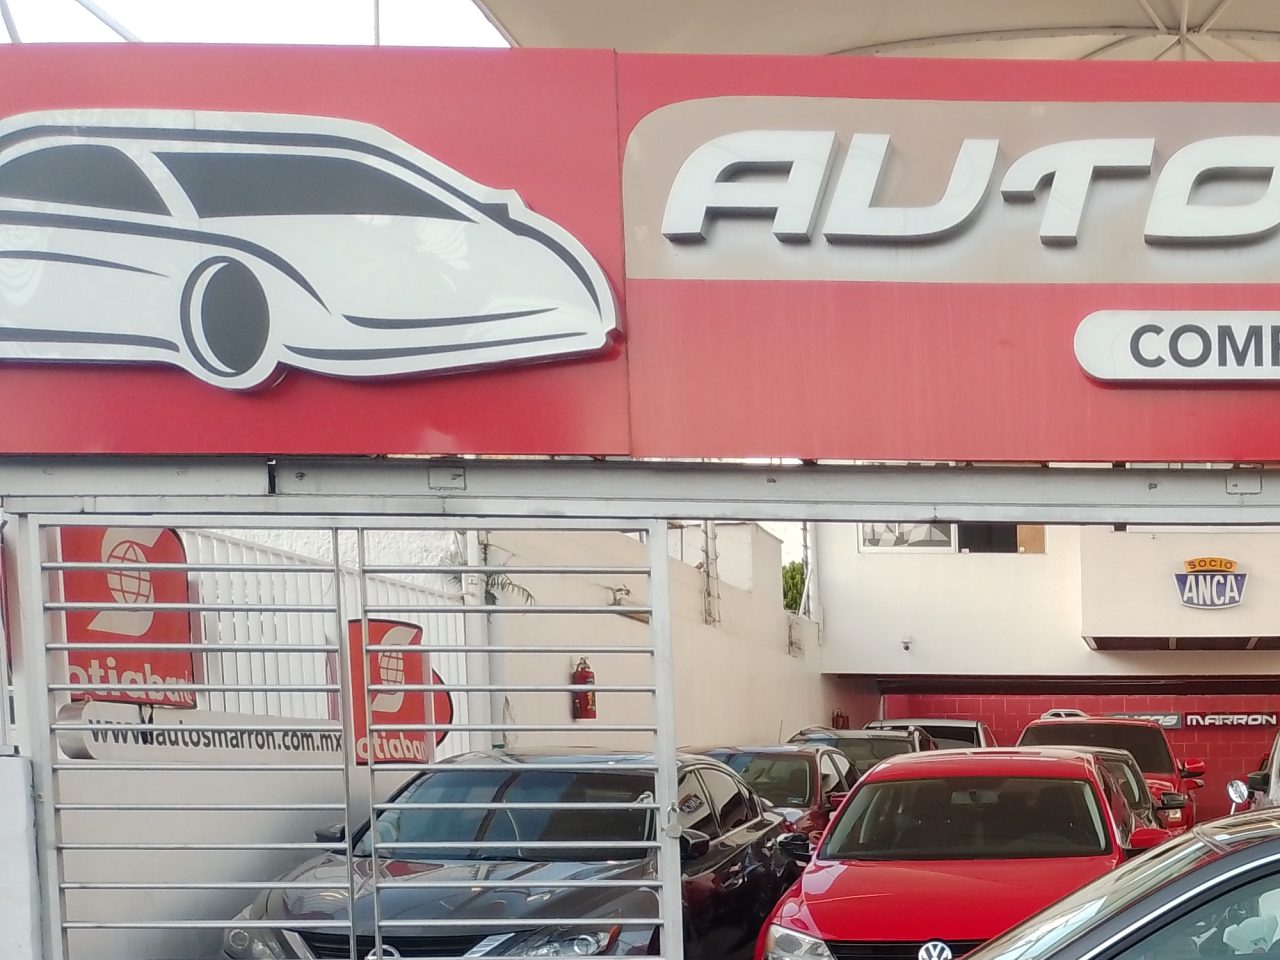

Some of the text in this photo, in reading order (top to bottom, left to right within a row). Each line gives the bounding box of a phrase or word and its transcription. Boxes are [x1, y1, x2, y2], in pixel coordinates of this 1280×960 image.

[1188, 560, 1233, 570] SOCIO
[1183, 575, 1240, 605] ANCA
[1187, 714, 1276, 725] MARRON
[88, 718, 342, 753] wwwautosmarron.com.mx
